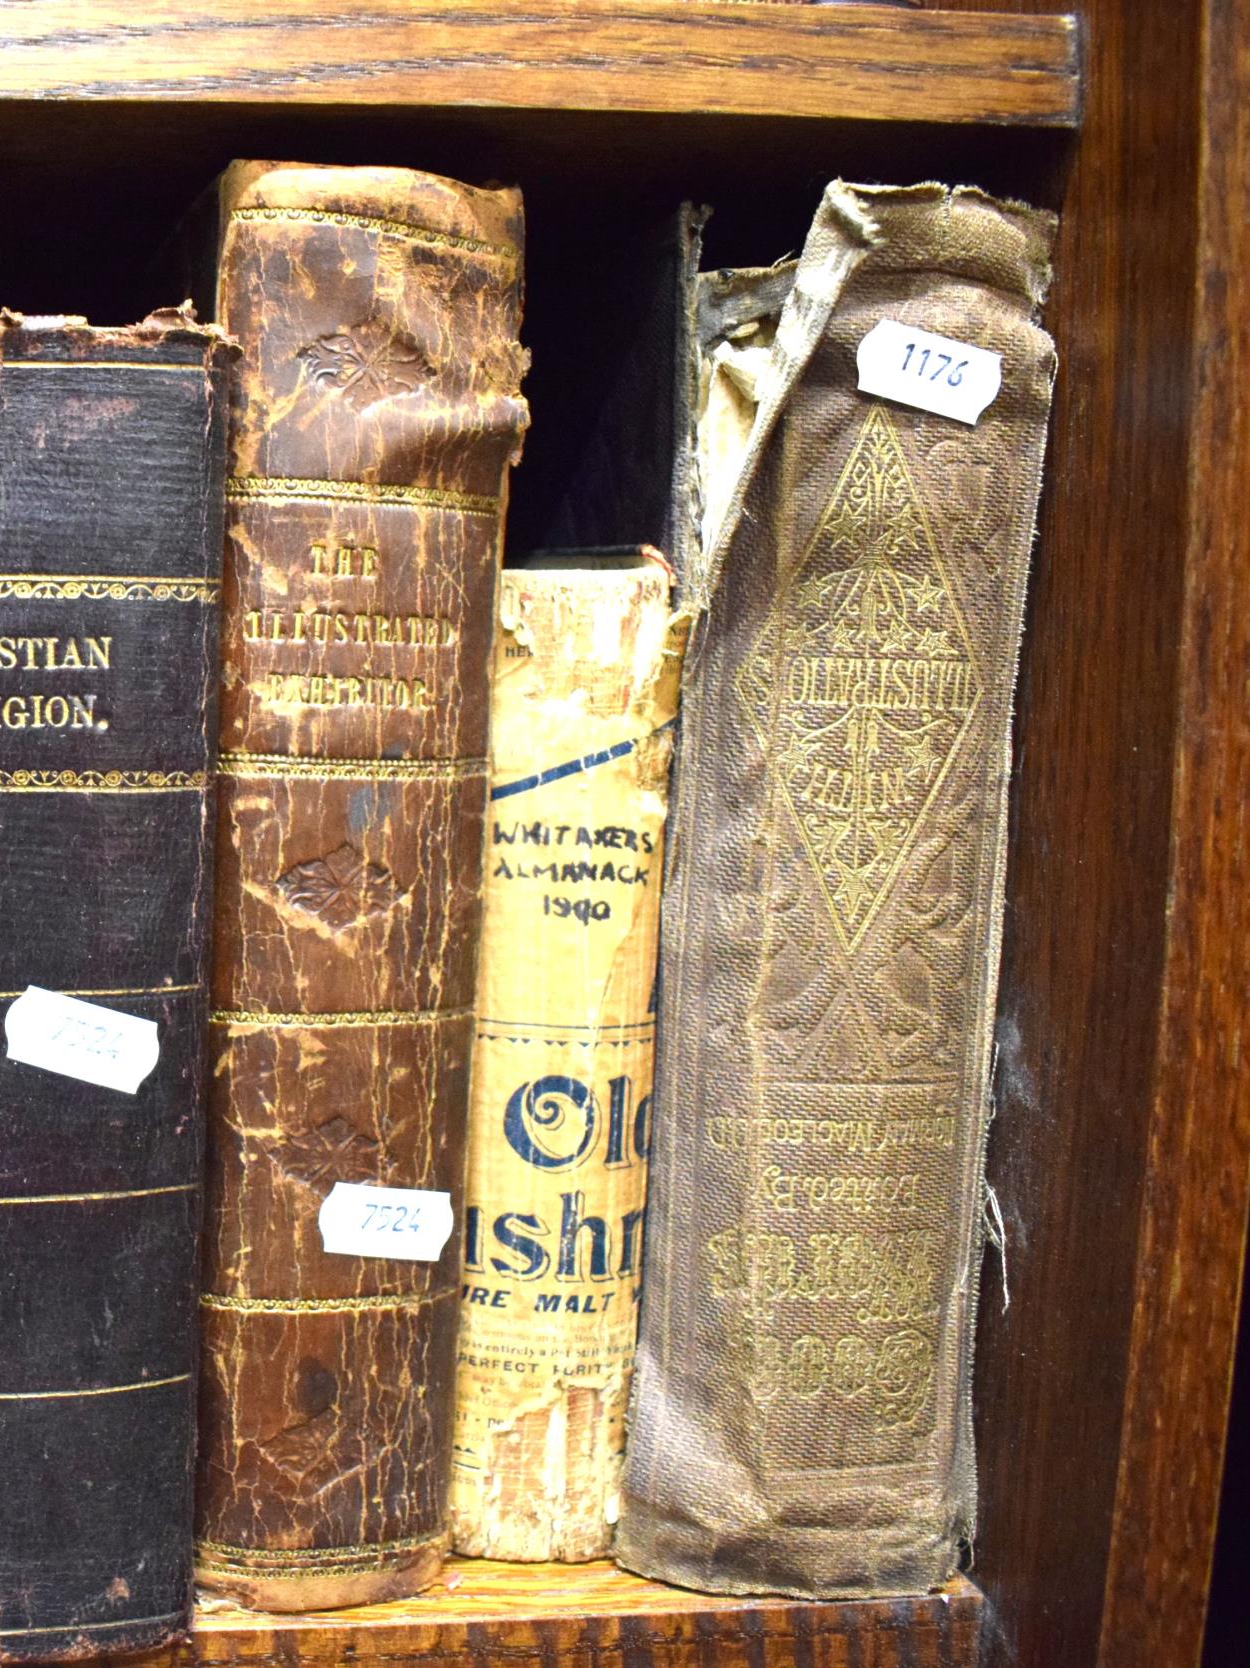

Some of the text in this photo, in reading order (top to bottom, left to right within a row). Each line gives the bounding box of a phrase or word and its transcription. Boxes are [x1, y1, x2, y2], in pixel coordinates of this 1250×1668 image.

[901, 342, 969, 387] 1176
[492, 821, 654, 854] WHITAKERS
[493, 859, 650, 887] ALMANACK
[360, 1203, 422, 1233] 7524
[533, 1291, 616, 1314] MALT
[458, 1352, 540, 1375] PERFECT
